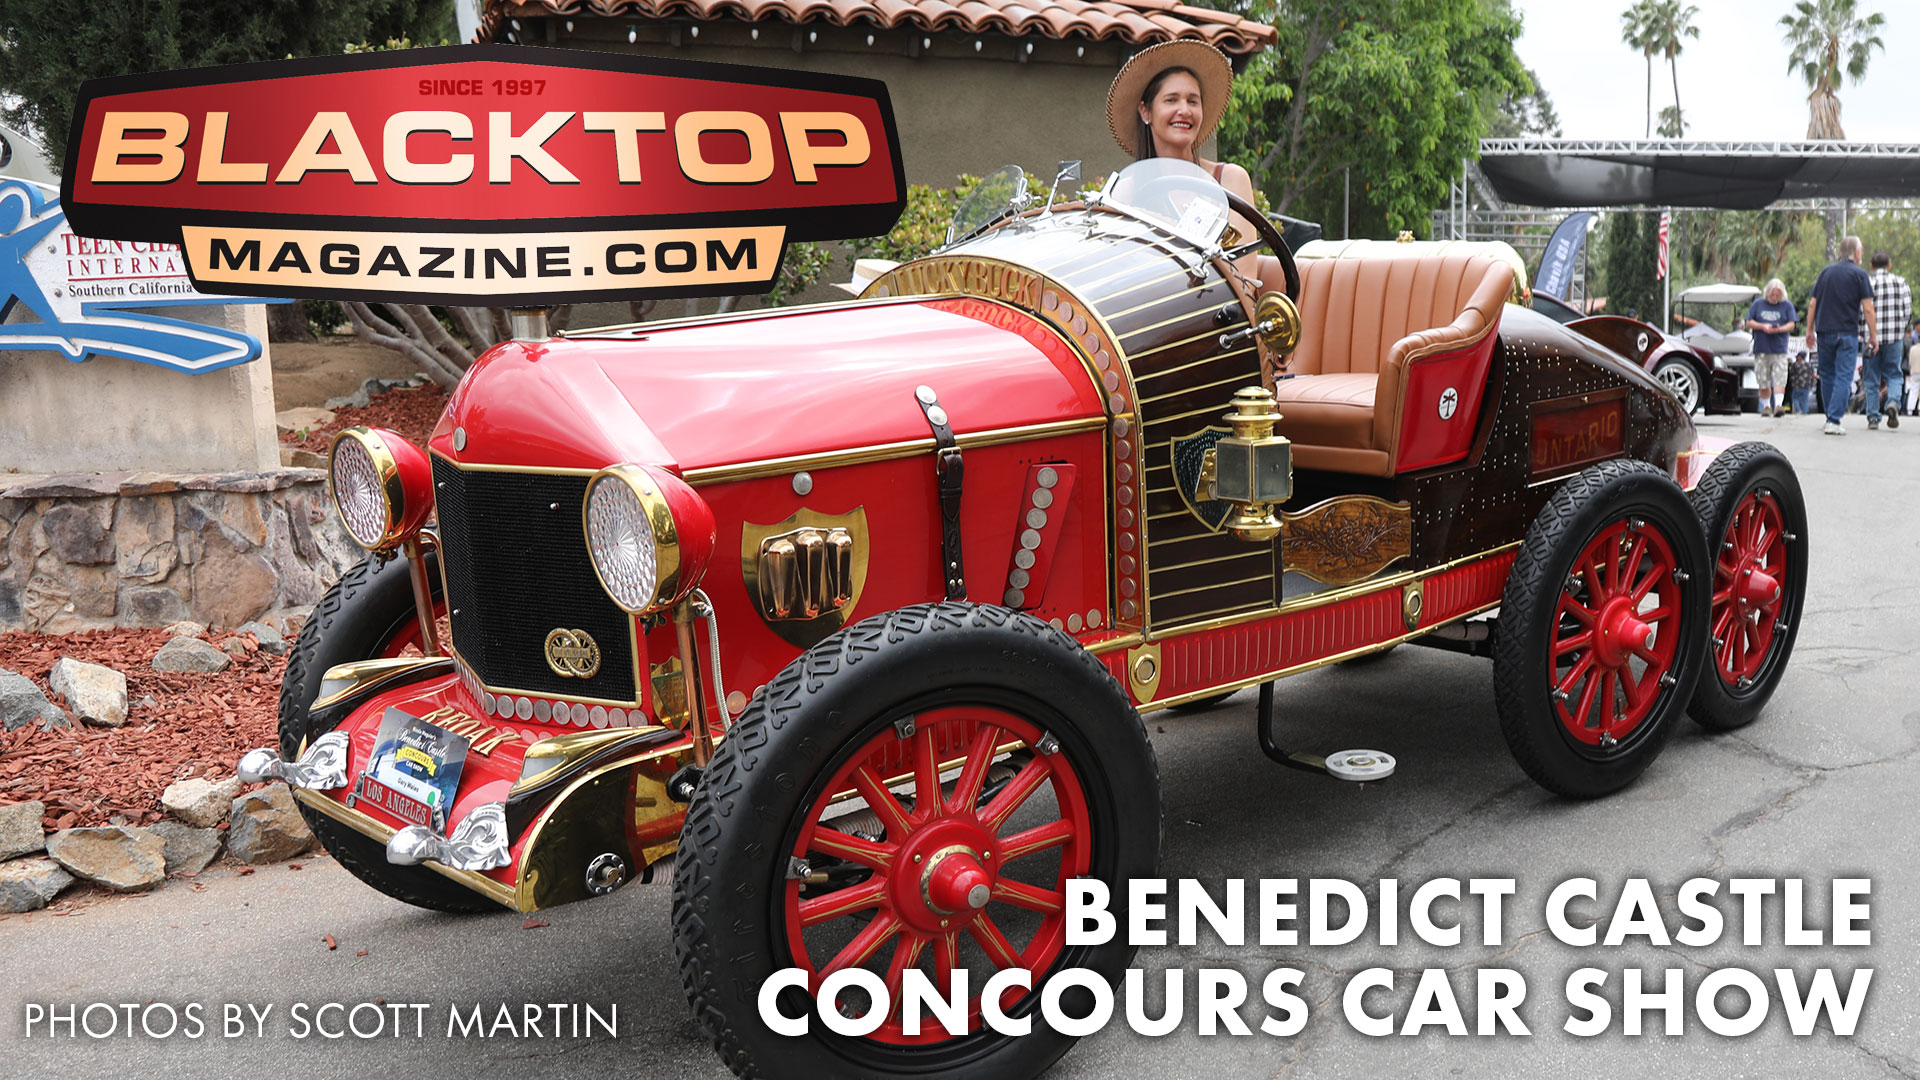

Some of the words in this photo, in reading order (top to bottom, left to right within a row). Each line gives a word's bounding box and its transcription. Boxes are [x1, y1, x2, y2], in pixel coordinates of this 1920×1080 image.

[60, 233, 124, 256] TEEN
[1556, 238, 1571, 261] USA
[67, 256, 184, 276] INTERNA
[68, 283, 124, 298] Southern
[128, 281, 193, 296] California
[1535, 410, 1619, 466] ONTARIO
[404, 748, 430, 765] CONCOURS
[405, 760, 415, 768] CAR
[413, 763, 424, 773] SHOW
[366, 780, 384, 803] LOS
[385, 790, 427, 825] ANGELES
